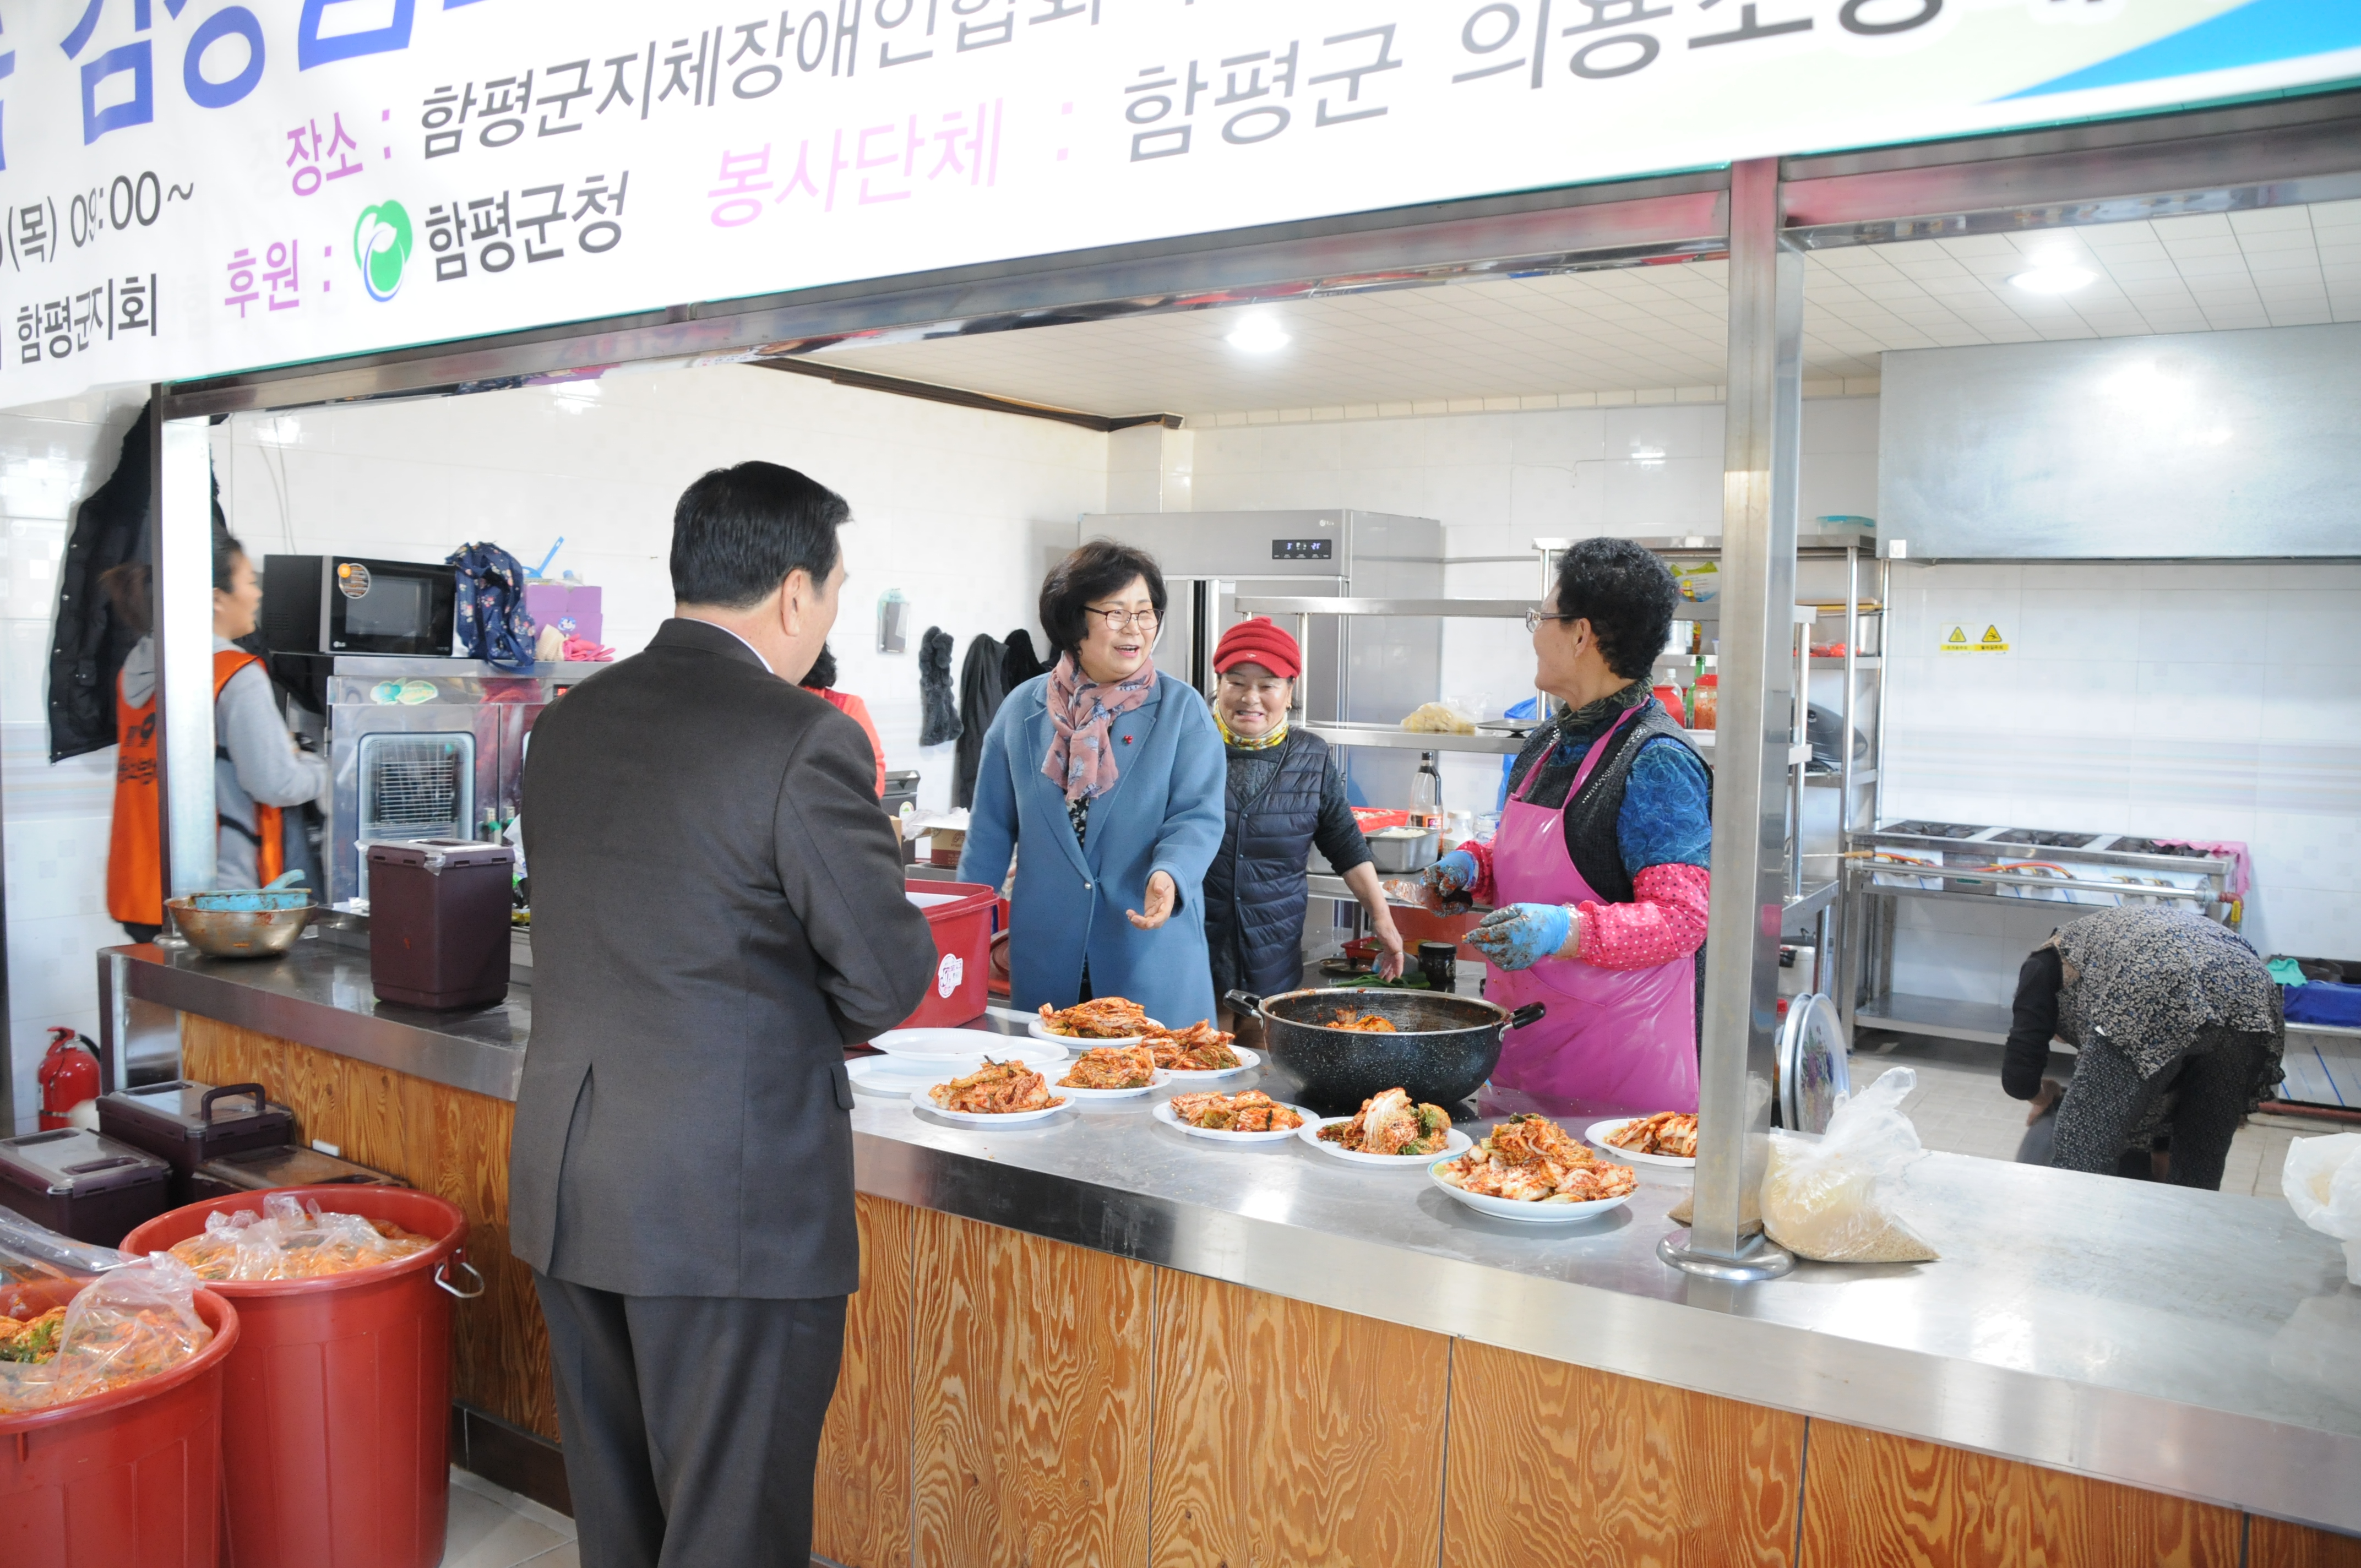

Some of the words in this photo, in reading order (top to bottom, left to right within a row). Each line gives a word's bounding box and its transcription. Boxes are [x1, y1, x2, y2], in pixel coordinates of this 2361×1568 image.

[286, 112, 363, 197] 장소
[707, 97, 1003, 228] 봉사단체
[1124, 23, 1403, 162] 함평군
[1451, 0, 2103, 89] 의용소
[0, 195, 57, 273] (목)
[225, 239, 300, 318] 후원
[425, 170, 629, 282] 함평군청
[17, 273, 157, 364] 함평군지회
